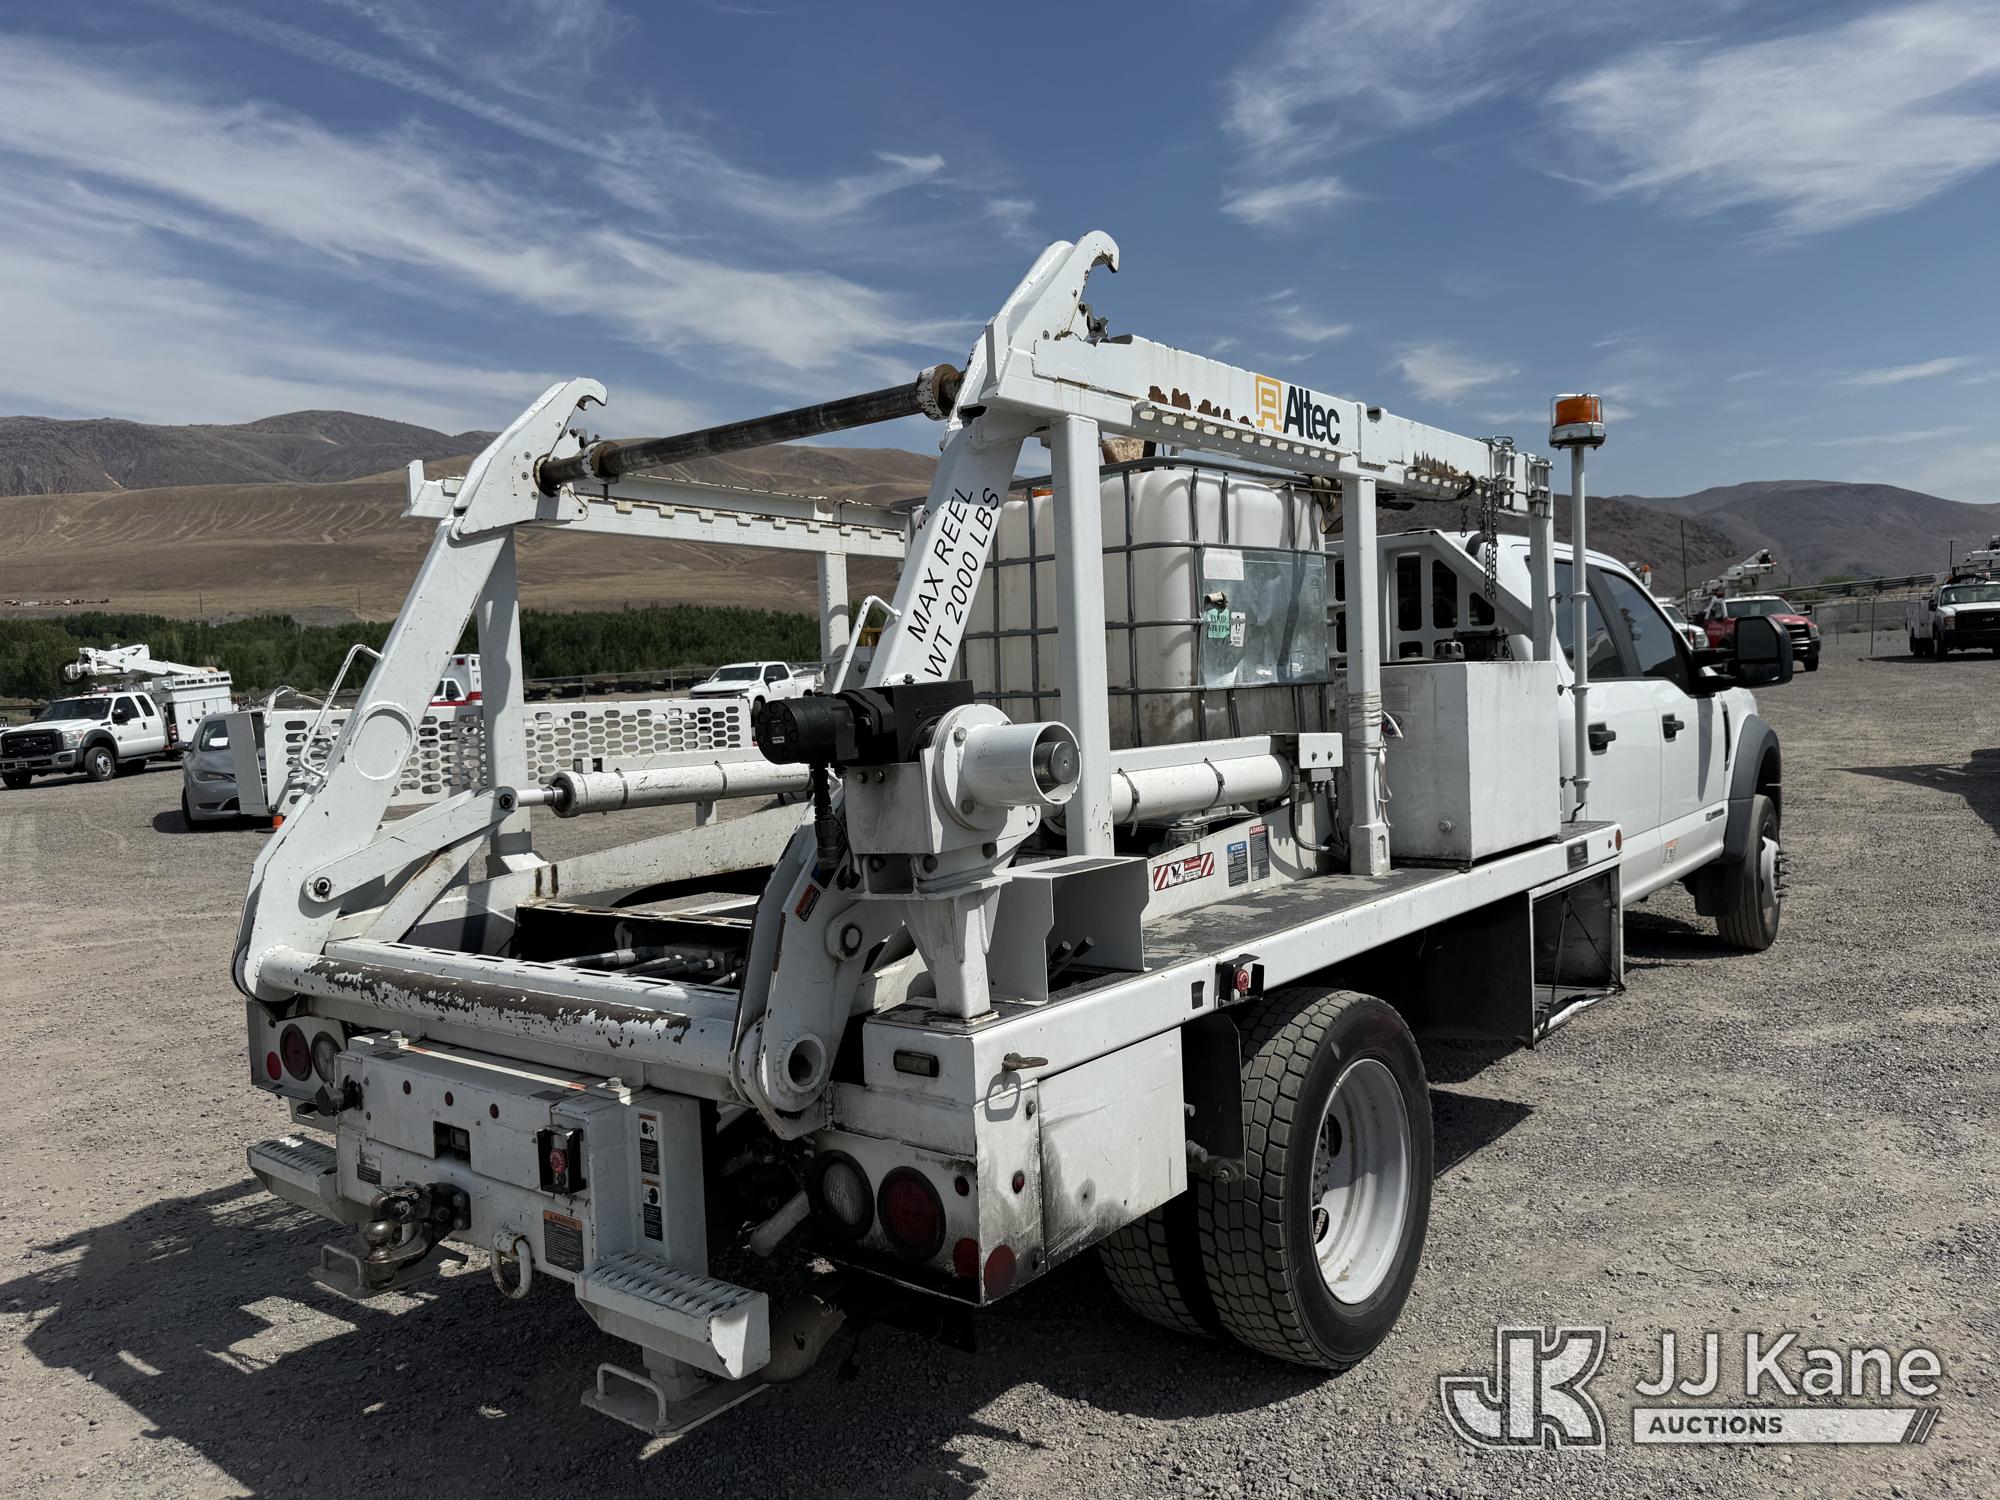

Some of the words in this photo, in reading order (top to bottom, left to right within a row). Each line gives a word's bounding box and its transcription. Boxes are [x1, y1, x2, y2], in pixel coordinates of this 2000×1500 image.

[1283, 385, 1340, 445] Altec
[907, 568, 944, 642] MAX
[934, 488, 973, 566] REEL
[924, 625, 952, 677] WT
[945, 551, 978, 625] 2000
[969, 487, 999, 548] LBS
